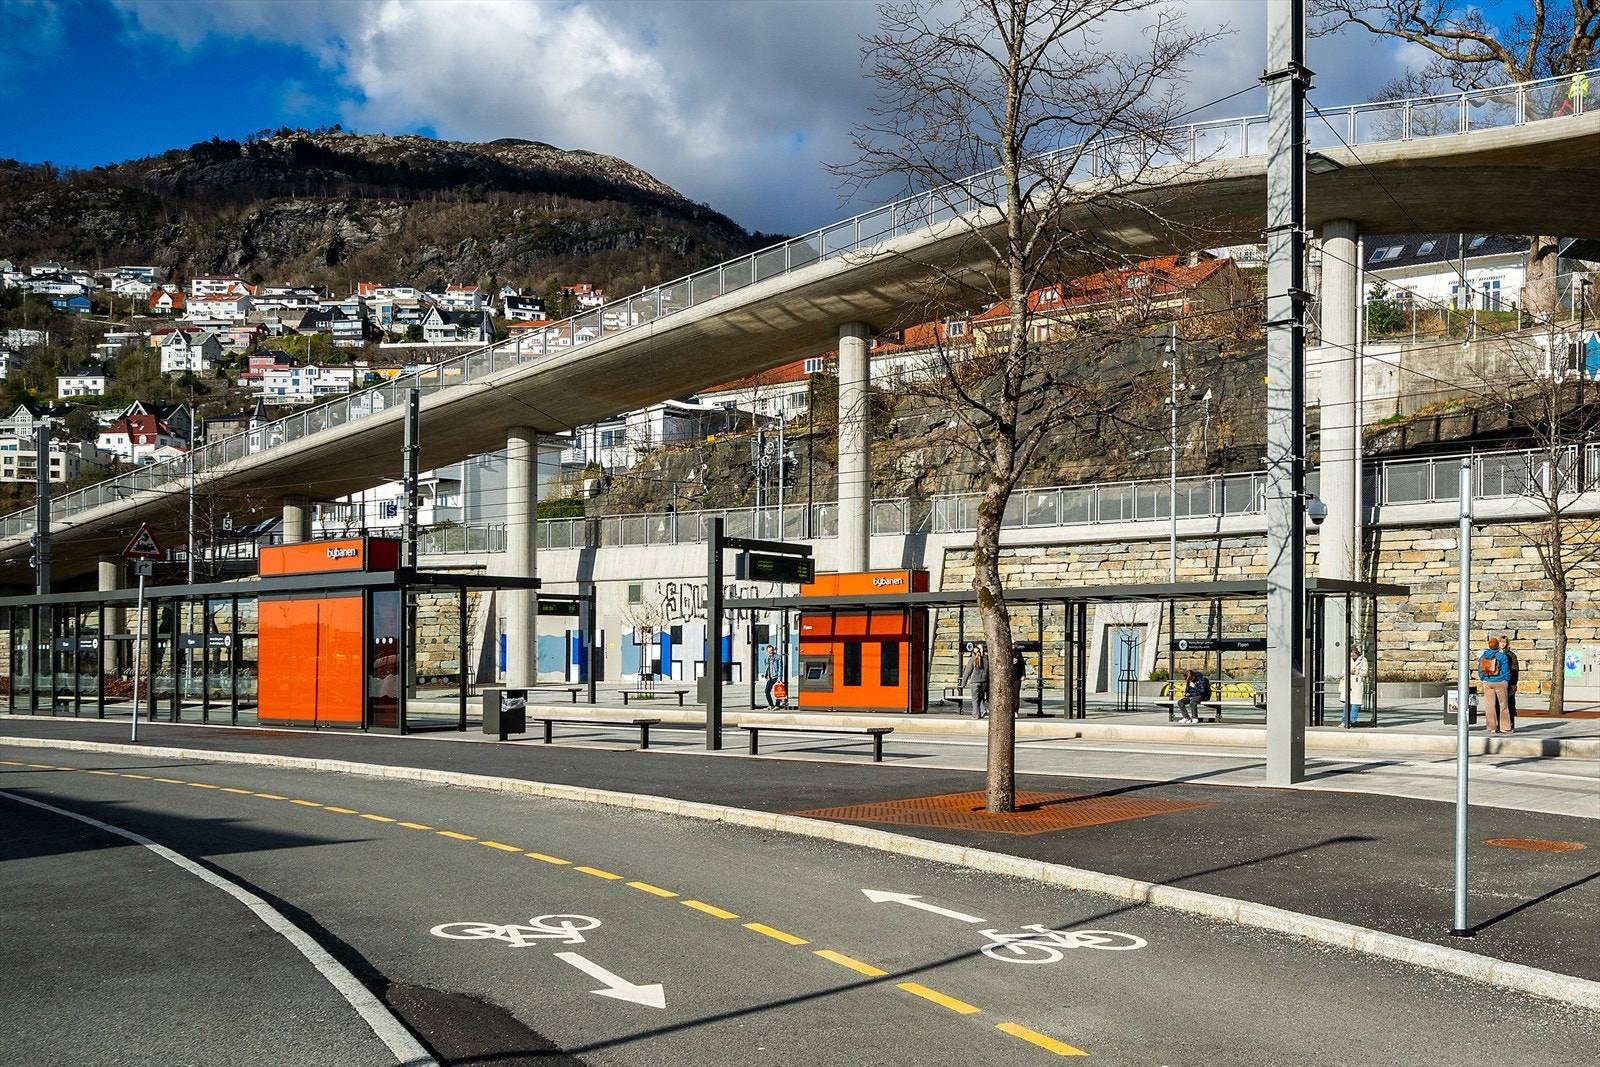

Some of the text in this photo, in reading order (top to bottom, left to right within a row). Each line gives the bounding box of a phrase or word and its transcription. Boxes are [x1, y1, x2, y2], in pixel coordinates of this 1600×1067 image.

[388, 506, 396, 516] S
[224, 520, 230, 530] 5
[327, 548, 356, 560] bybanen
[873, 577, 902, 586] bybanen
